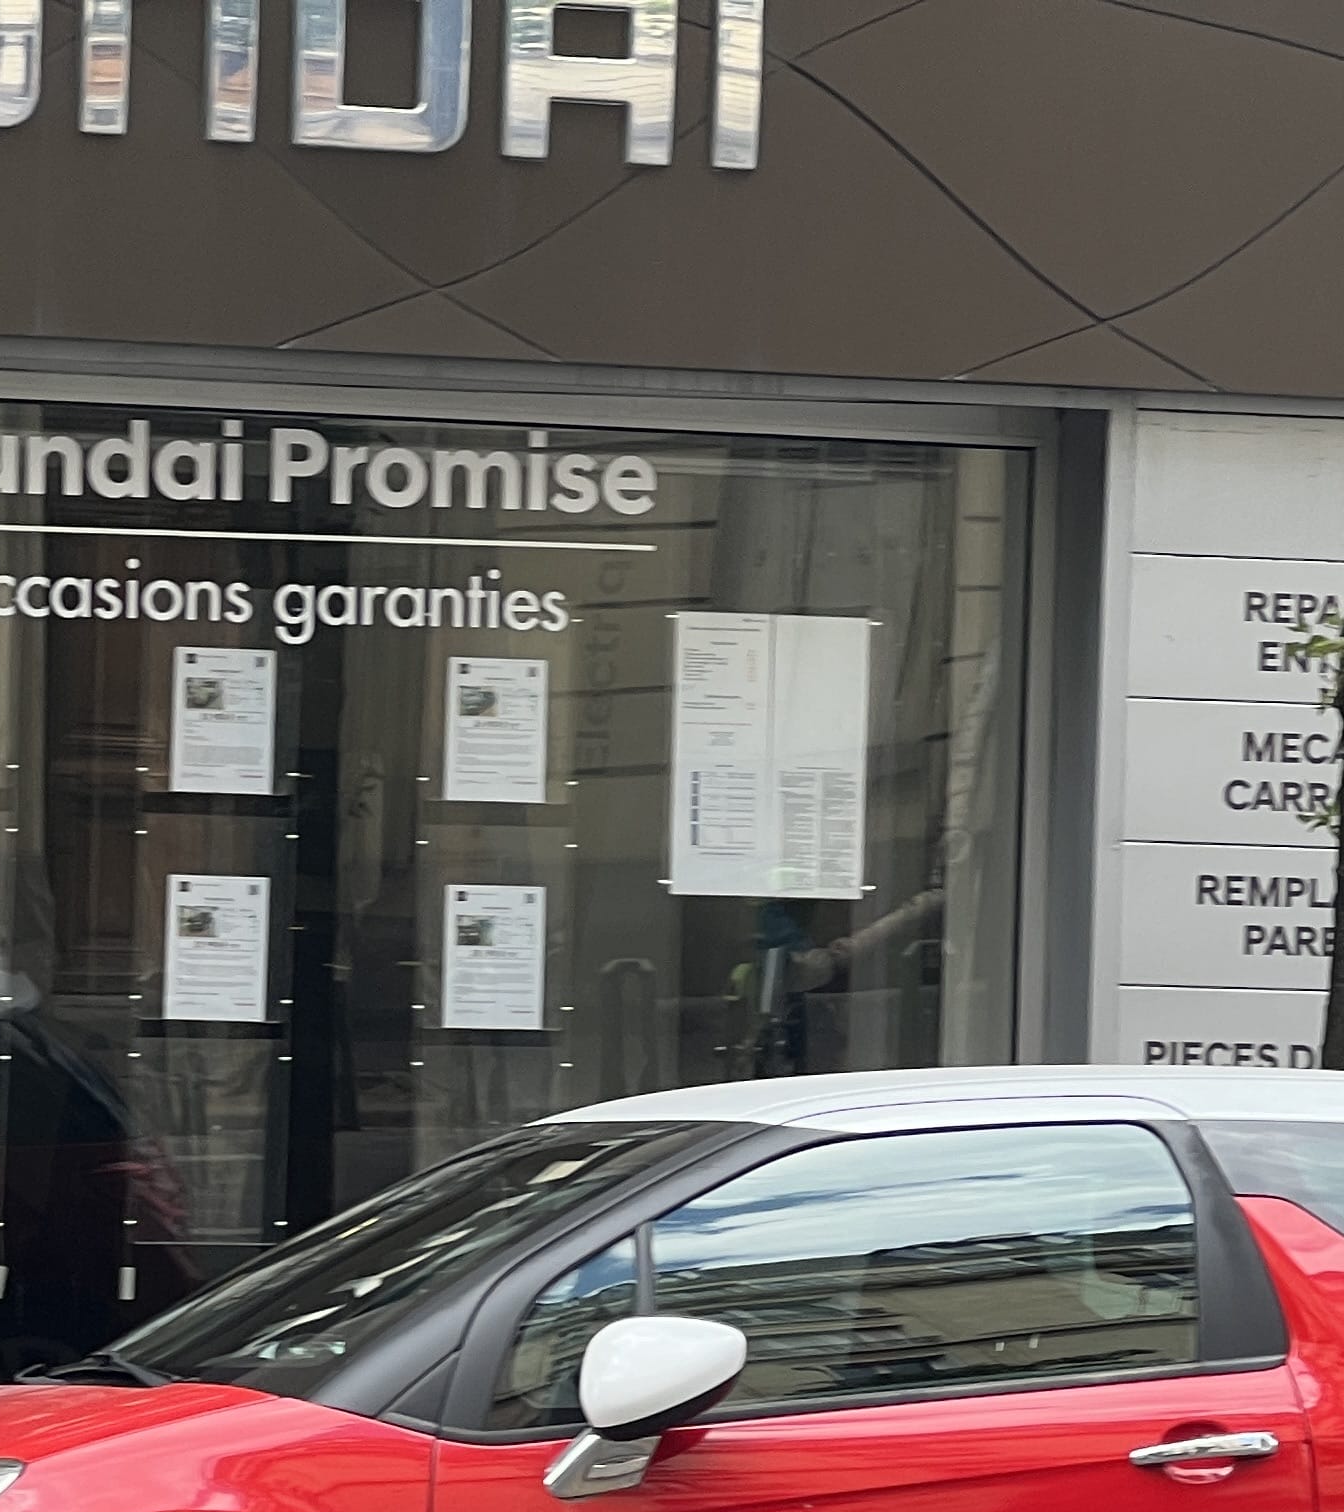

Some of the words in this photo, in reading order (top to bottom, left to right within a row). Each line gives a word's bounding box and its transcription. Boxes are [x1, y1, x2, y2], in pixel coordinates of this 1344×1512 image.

[269, 431, 657, 515] Promise
[274, 570, 570, 643] garanties
[1144, 1041, 1277, 1068] PIECES
